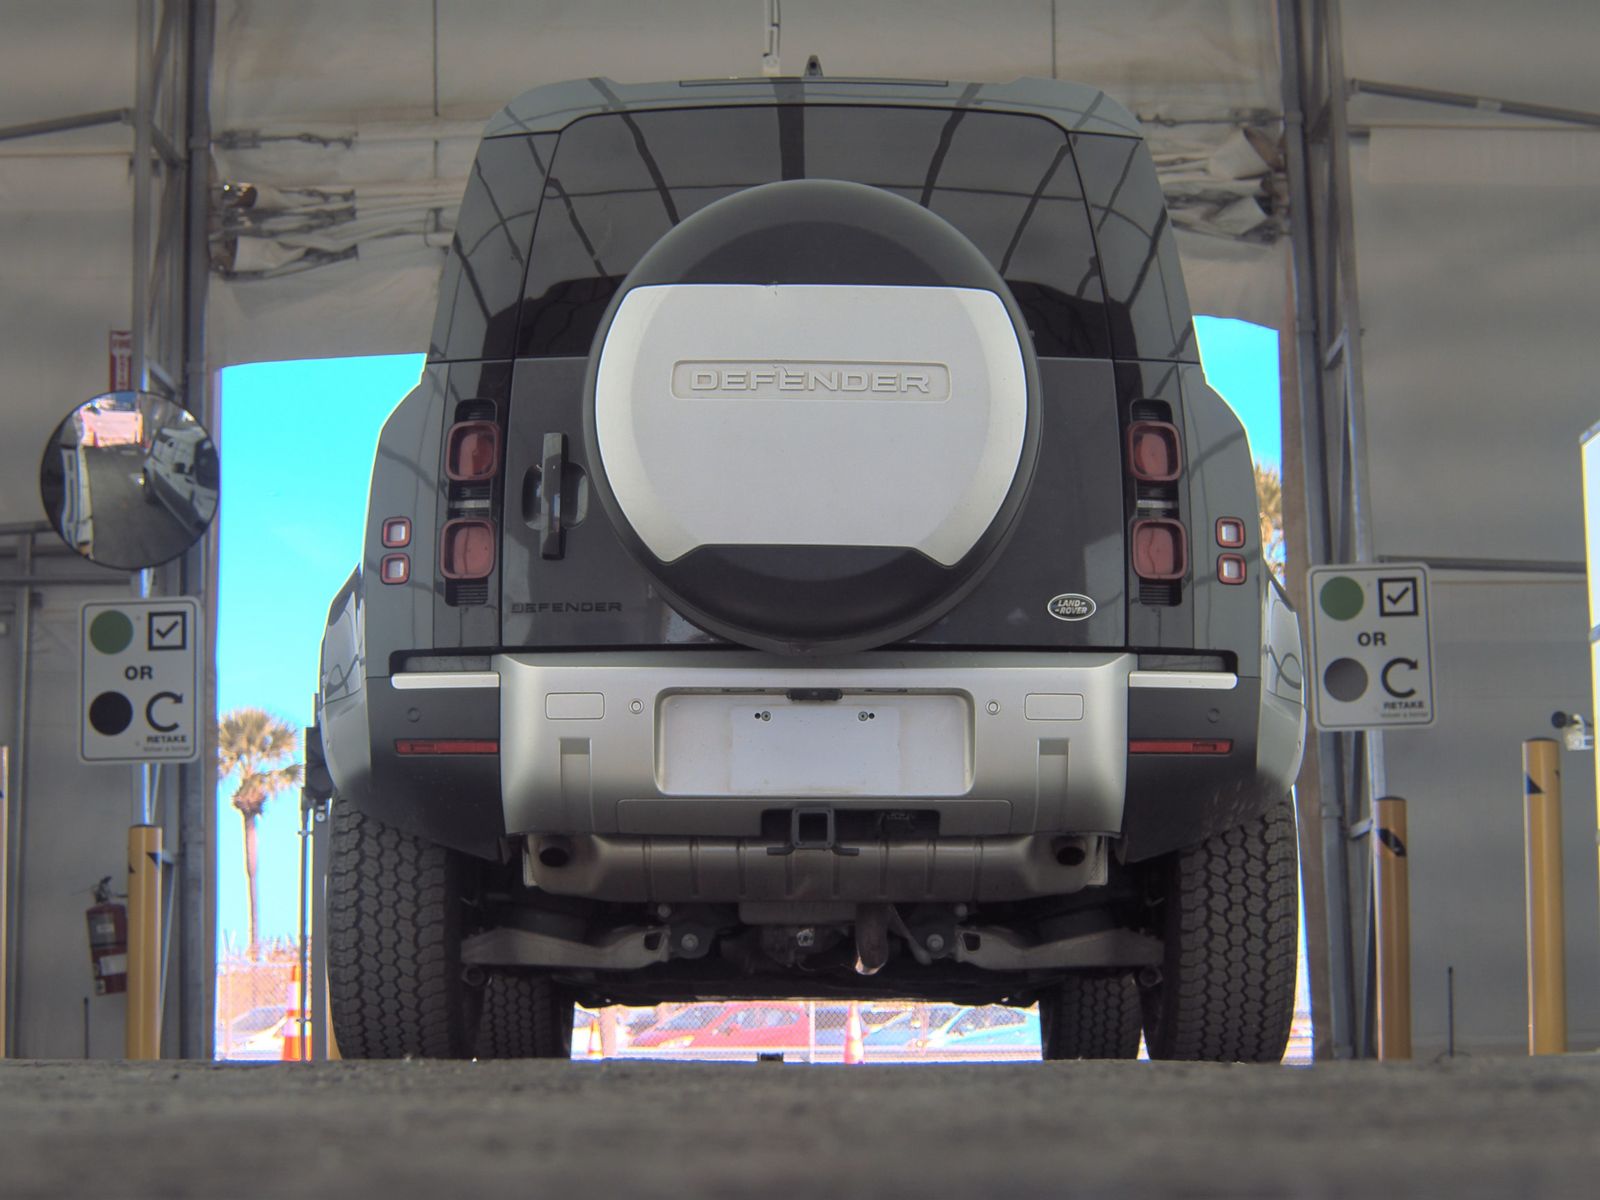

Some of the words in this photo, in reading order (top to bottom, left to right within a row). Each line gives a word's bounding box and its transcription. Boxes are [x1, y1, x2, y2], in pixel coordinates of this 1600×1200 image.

[691, 370, 930, 393] DEFENDER
[511, 602, 622, 613] DEFENDER
[1357, 632, 1386, 646] OR
[124, 666, 153, 680] OR
[1383, 701, 1424, 710] RETAKE
[146, 735, 187, 743] RETAKE
